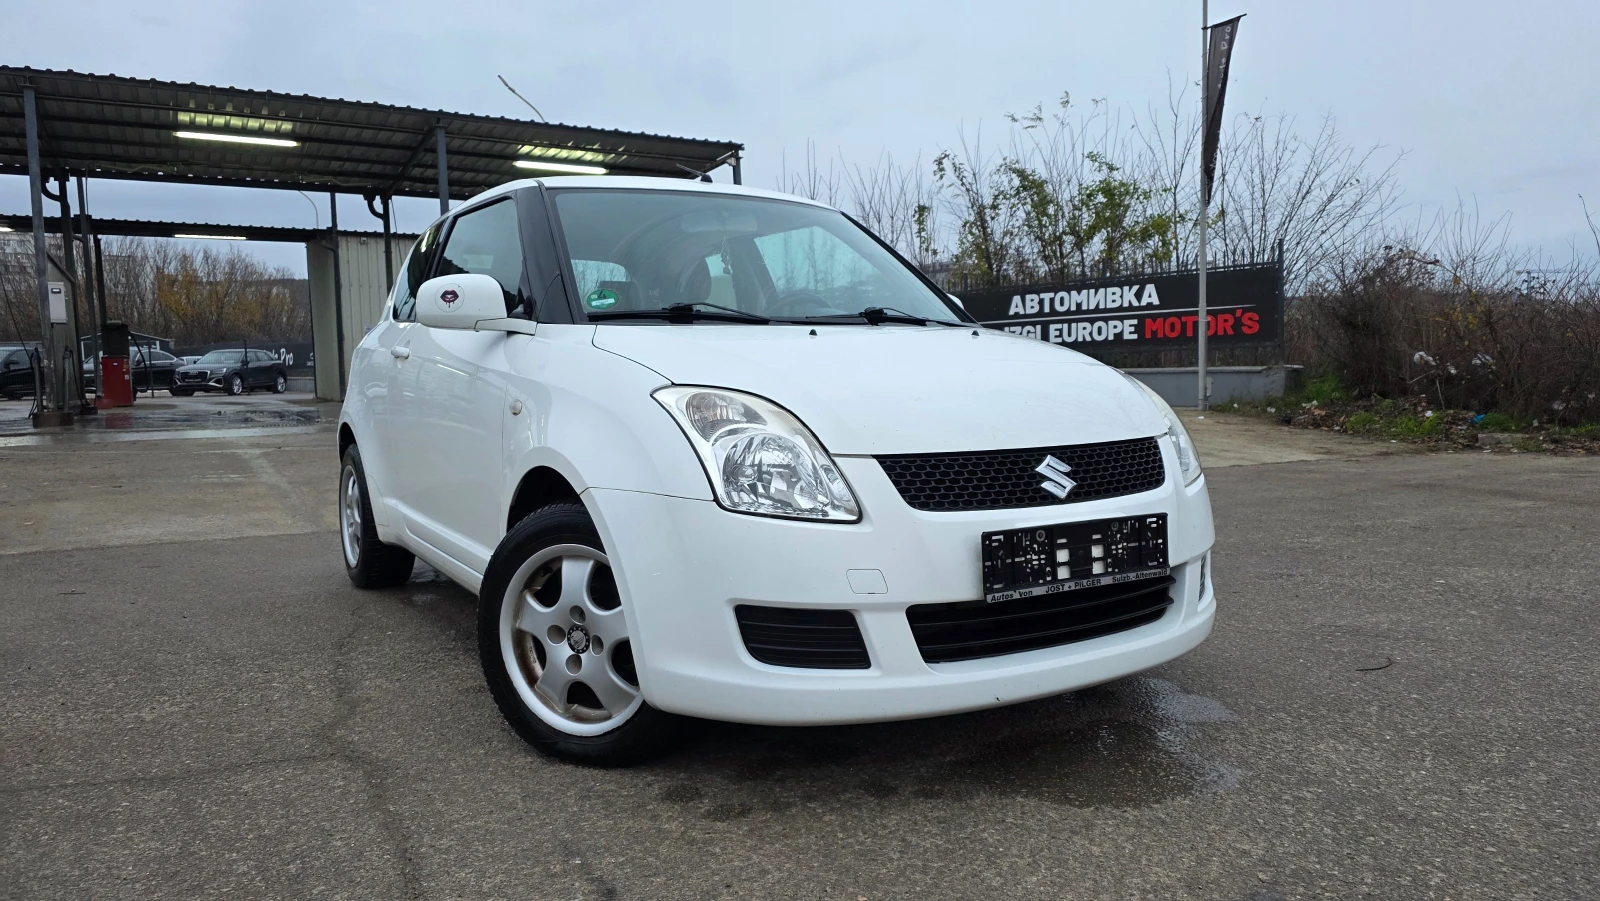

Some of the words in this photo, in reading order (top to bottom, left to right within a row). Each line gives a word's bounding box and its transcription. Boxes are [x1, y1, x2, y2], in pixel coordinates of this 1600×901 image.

[1008, 284, 1160, 315] АВТОМИВКА
[1049, 319, 1138, 343] EUROPE
[280, 347, 294, 366] Pro
[1045, 584, 1066, 593] JOST
[1074, 578, 1102, 589] PILGER
